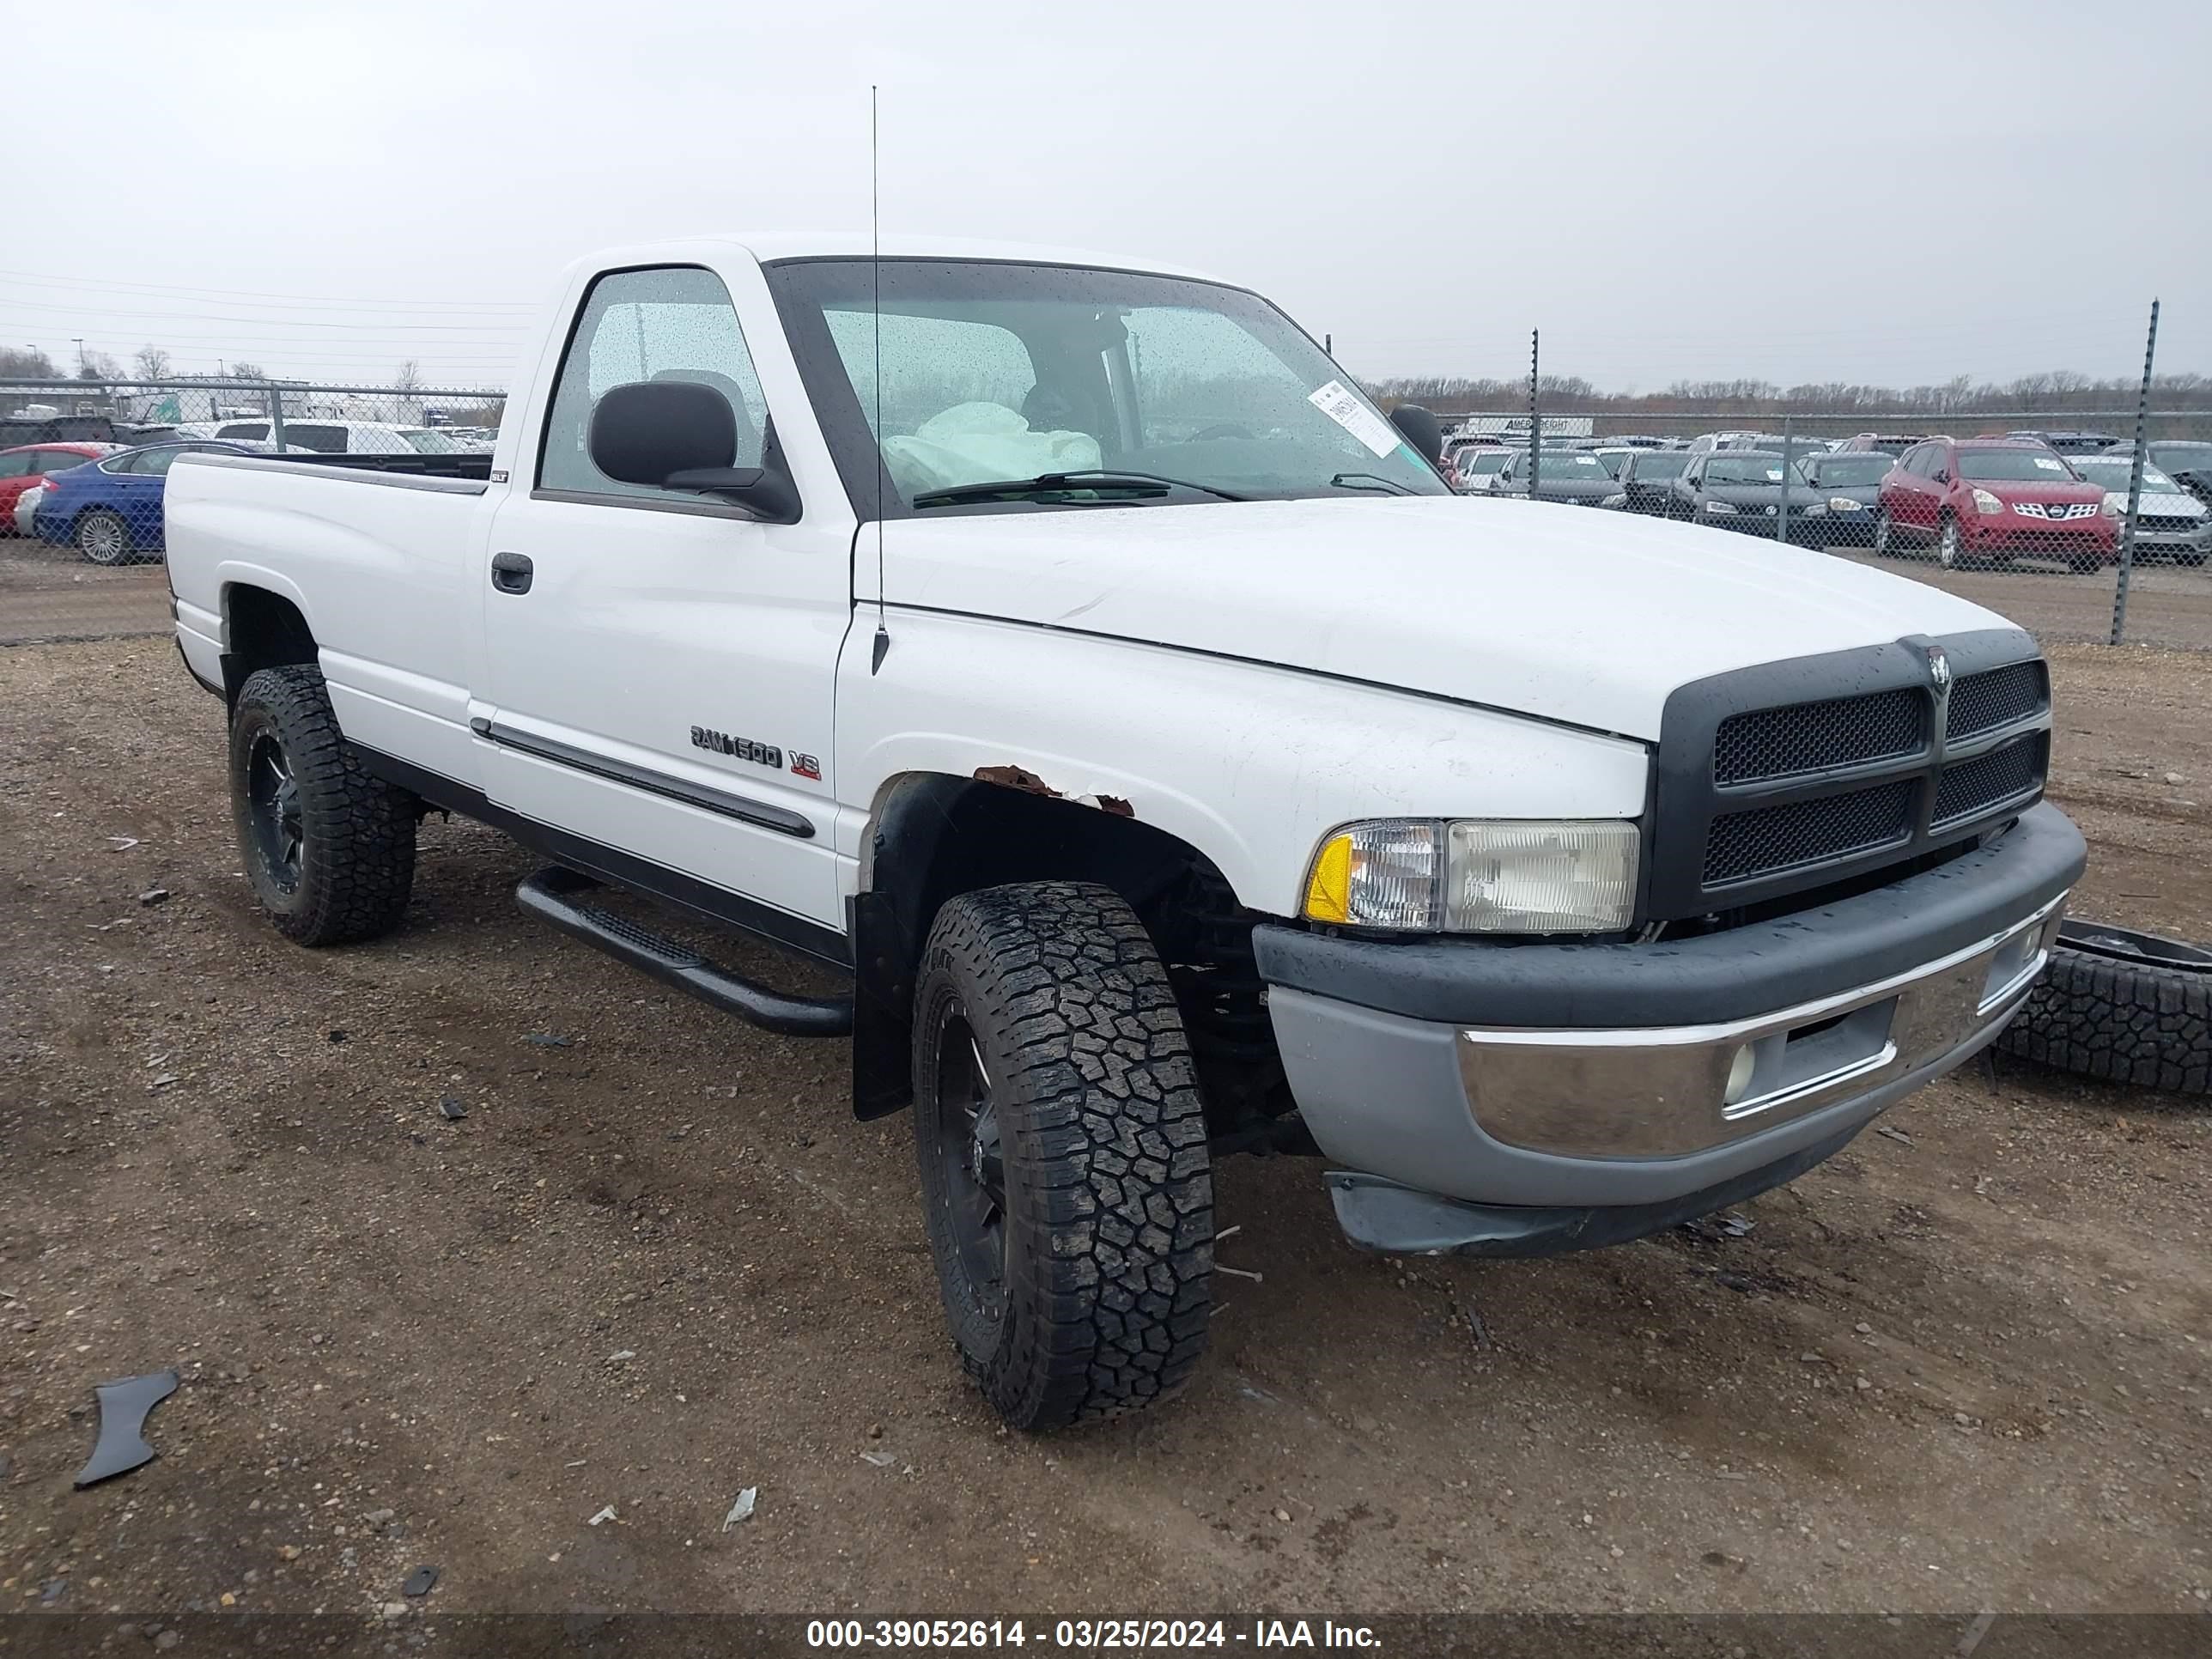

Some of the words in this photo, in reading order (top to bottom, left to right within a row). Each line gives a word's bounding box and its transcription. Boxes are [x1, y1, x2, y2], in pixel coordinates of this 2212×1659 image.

[491, 473, 507, 482] SLT
[690, 726, 730, 754] RAM
[733, 736, 782, 769] 1500
[788, 750, 819, 772] V8
